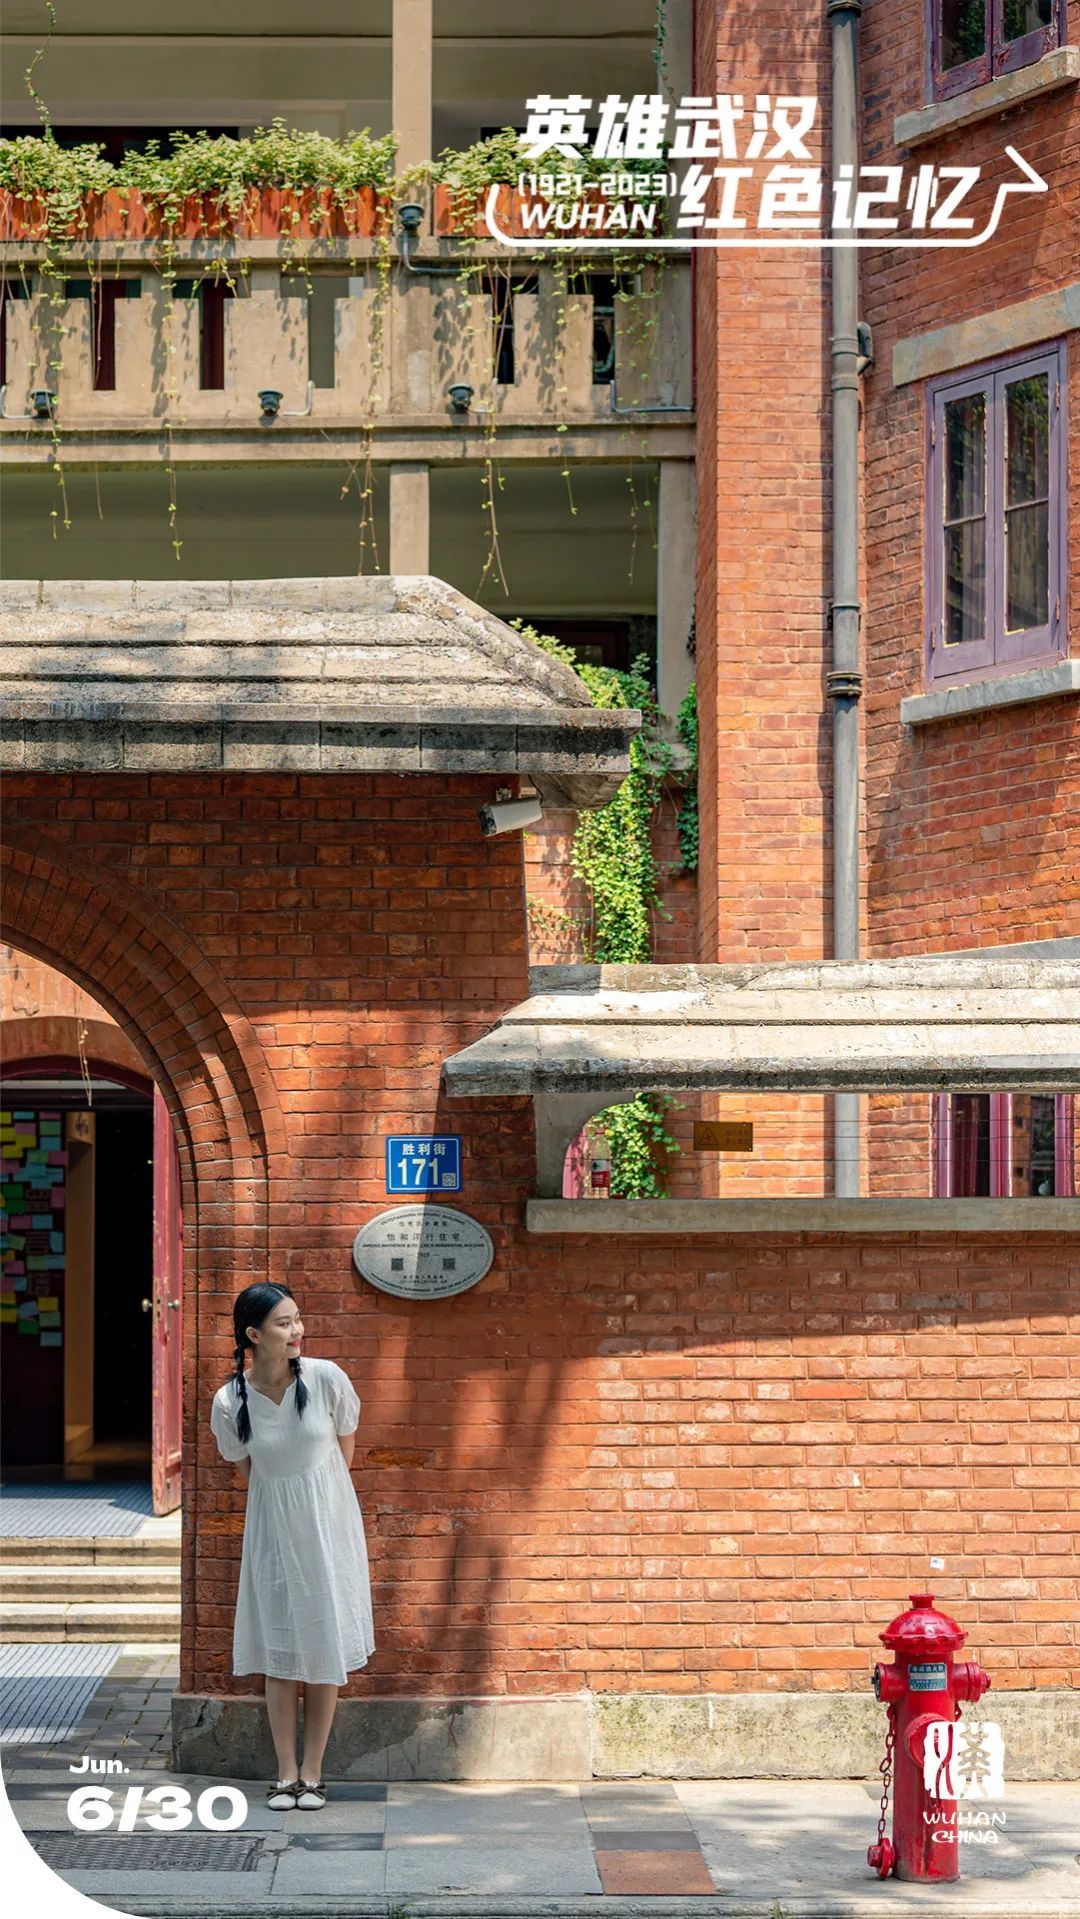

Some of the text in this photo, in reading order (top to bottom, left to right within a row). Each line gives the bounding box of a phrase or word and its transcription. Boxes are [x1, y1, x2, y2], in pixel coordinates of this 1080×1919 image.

[402, 1143, 446, 1156] 胜利街
[397, 1158, 439, 1186] 171
